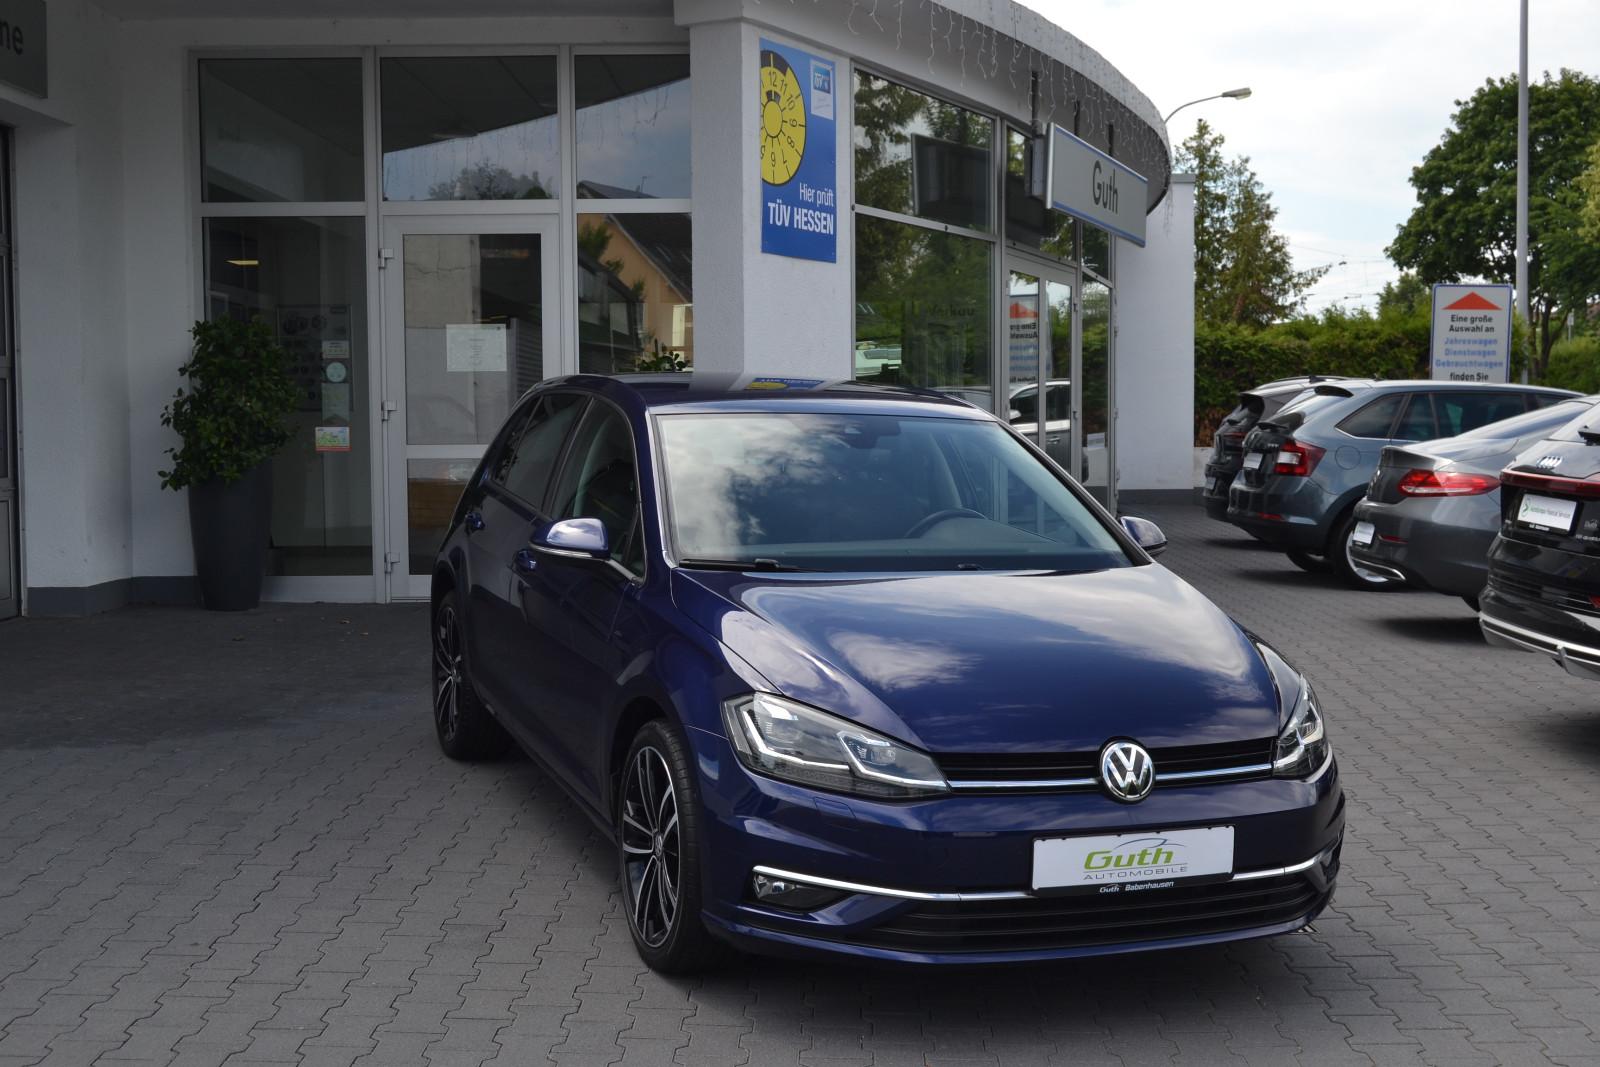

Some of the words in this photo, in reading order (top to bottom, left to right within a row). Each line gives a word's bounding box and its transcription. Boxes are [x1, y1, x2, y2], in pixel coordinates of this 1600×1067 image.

[768, 71, 777, 87] 12
[786, 94, 796, 111] 10
[786, 135, 795, 148] 8
[799, 182, 816, 203] Hier
[816, 187, 834, 208] prüft
[1092, 160, 1119, 215] Guth
[767, 198, 791, 227] TÜV
[793, 207, 834, 235] HESSEN
[1450, 314, 1468, 323] Eine
[1470, 314, 1494, 324] große
[1449, 324, 1483, 333] Auswahl
[1444, 337, 1498, 347] Jahreswagen
[1450, 372, 1475, 381] finden
[1476, 372, 1489, 381] Sie
[1101, 740, 1155, 800] VW
[1084, 847, 1174, 870] Guth
[1083, 866, 1189, 880] AUTOMOBILE
[1099, 885, 1120, 893] Guth
[1125, 881, 1175, 892] Babenhausen
